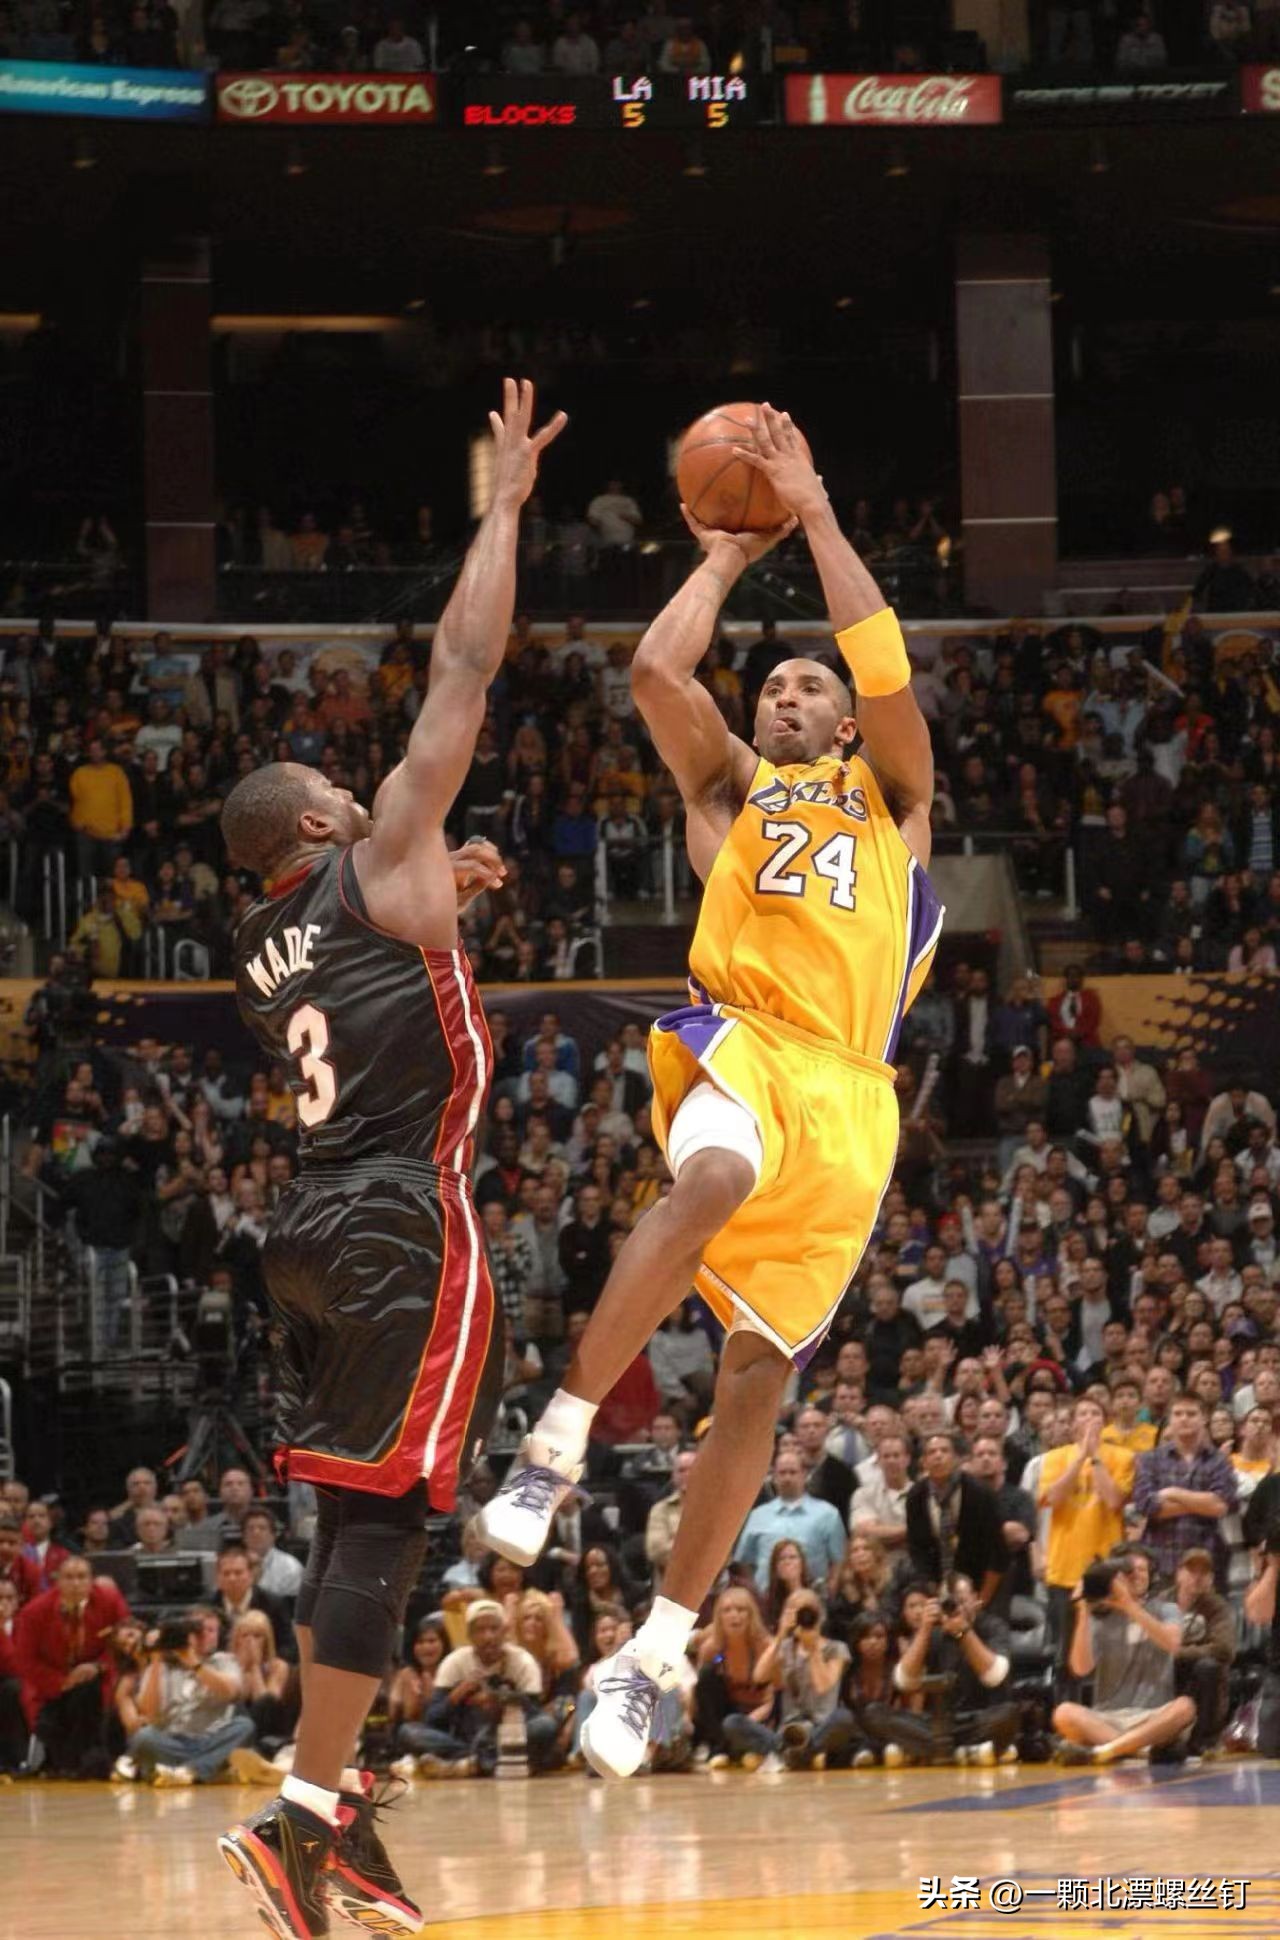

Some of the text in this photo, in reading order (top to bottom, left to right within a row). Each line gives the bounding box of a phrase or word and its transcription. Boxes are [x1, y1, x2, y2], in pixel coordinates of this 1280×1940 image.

[112, 79, 206, 106] Express
[282, 83, 431, 114] TOYOTA
[613, 76, 747, 101] LA MIA
[464, 102, 730, 128] BLOCKS 5 5
[755, 819, 857, 912] 24
[246, 923, 321, 998] WADE
[287, 1003, 338, 1128] 3
